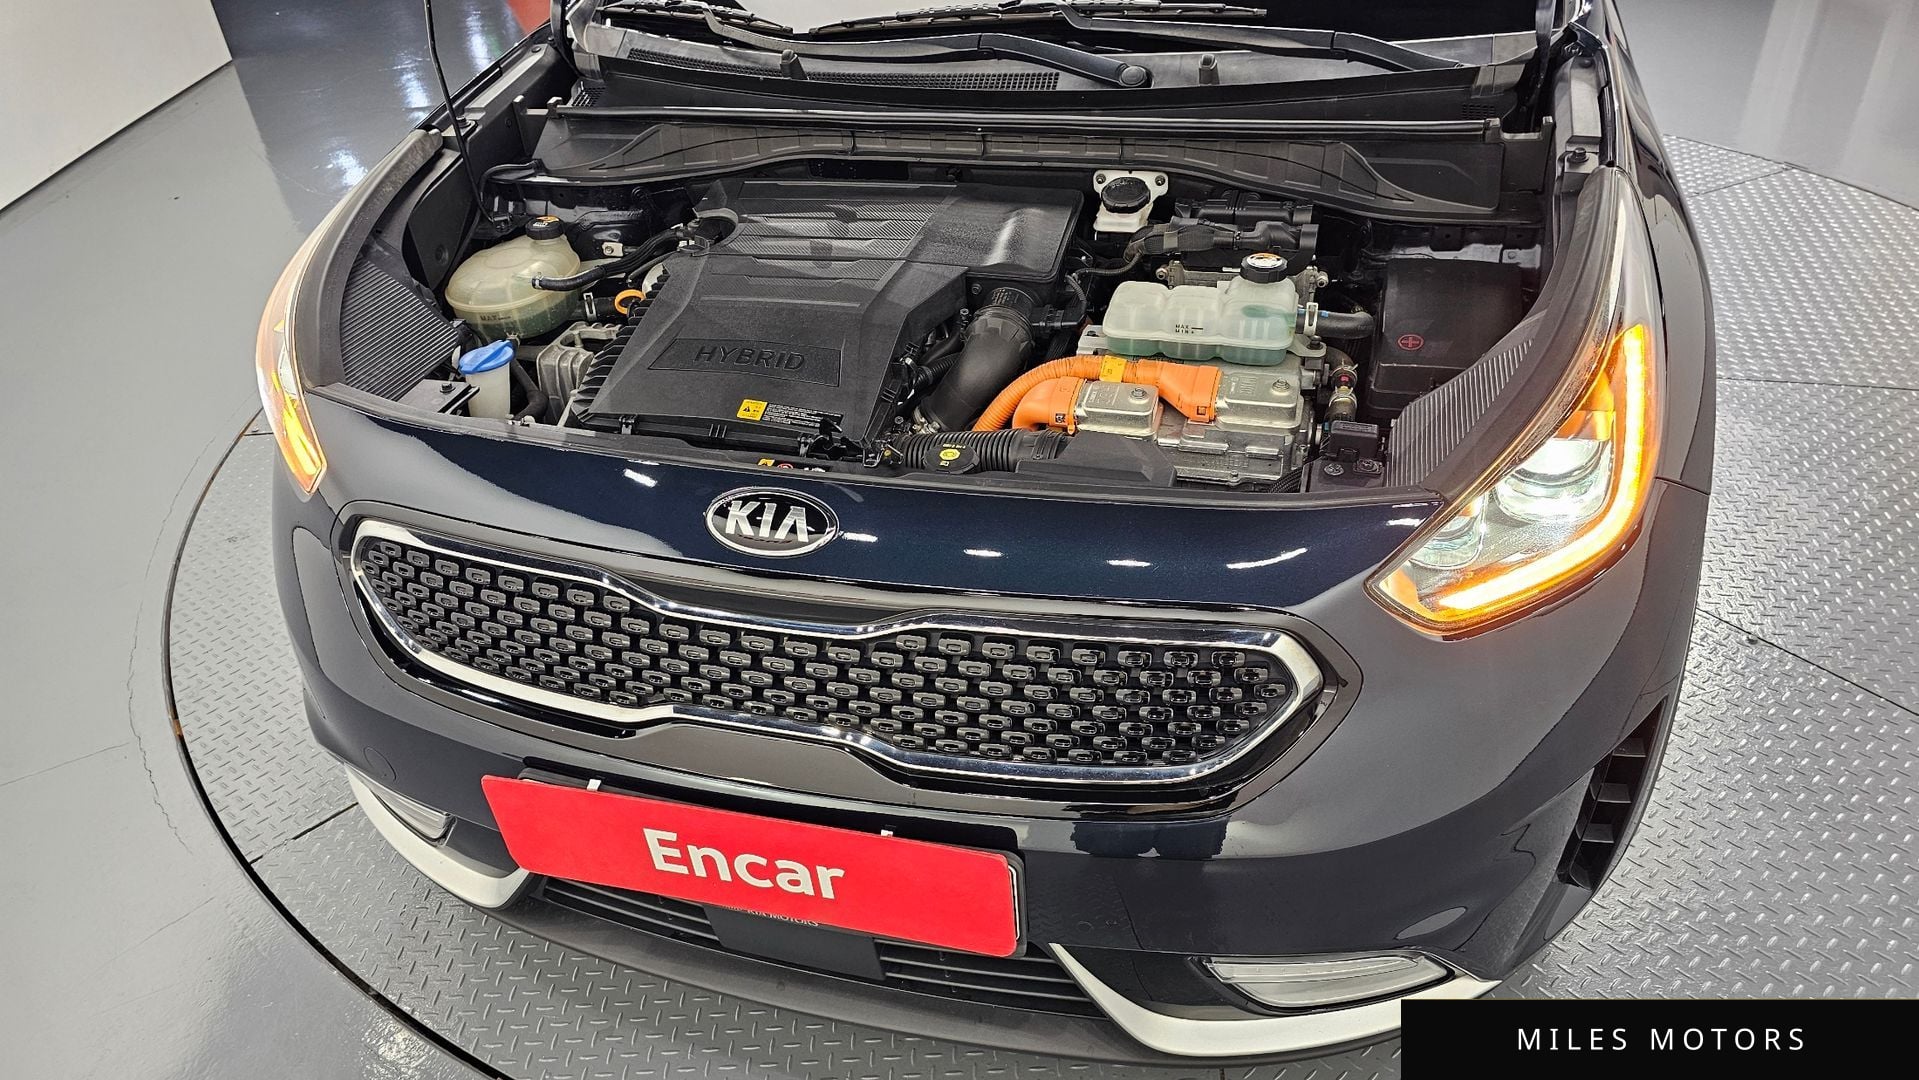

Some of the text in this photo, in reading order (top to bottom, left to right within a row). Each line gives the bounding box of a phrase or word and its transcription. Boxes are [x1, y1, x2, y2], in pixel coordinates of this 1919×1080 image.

[693, 346, 804, 370] HYBRID
[725, 500, 809, 542] KIA
[643, 828, 845, 900] Encar
